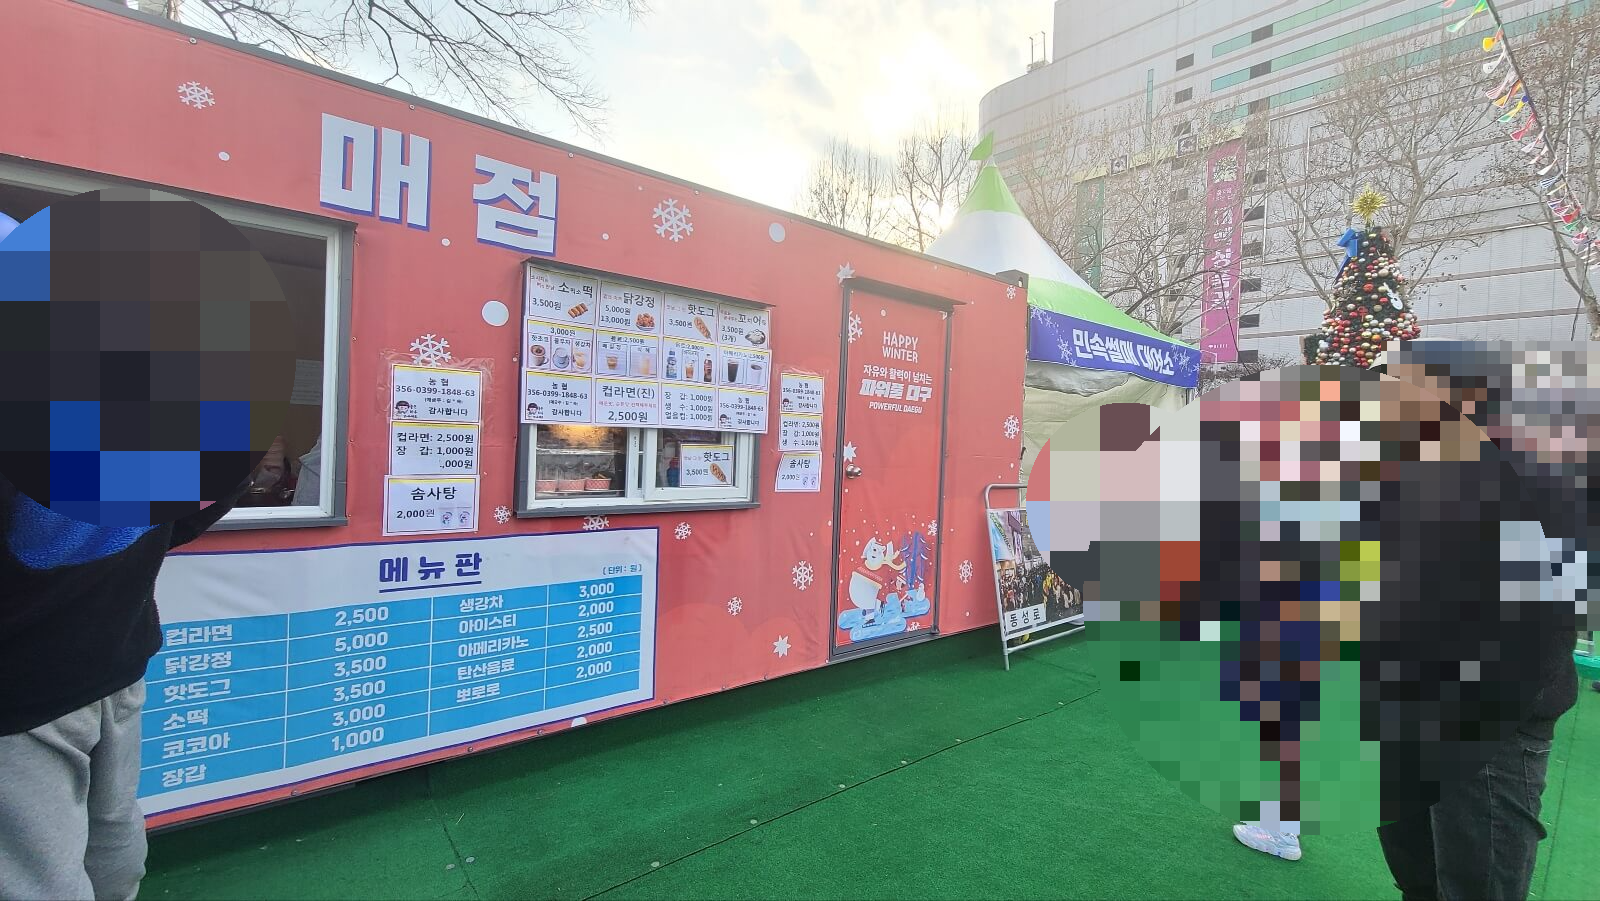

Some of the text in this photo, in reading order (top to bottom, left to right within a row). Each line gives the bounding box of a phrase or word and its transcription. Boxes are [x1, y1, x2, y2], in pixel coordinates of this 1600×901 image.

[533, 298, 561, 311] 3,500원
[624, 292, 655, 308] 닭강정
[605, 305, 630, 316] 5,000원
[688, 304, 714, 317] 핫도그
[601, 315, 630, 327] 13,000원
[669, 318, 693, 328] 3,500원
[550, 327, 576, 337] 3,000원
[722, 326, 744, 335] 3,500원
[883, 331, 918, 350] HAPPY
[882, 346, 918, 363] WINTER
[1072, 328, 1175, 376] 민속썰매 대여소
[863, 364, 933, 385] 자유와 활력이 넘치는
[395, 385, 475, 397] 356-0399-1848-63
[527, 389, 588, 400] 356-0399-1848-63
[602, 385, 655, 399] 컵라면(진)
[690, 394, 713, 403] 1,000원
[428, 407, 468, 416] 감사합니다
[551, 408, 582, 417] 감사합니다
[690, 404, 713, 413] 1,000원
[868, 401, 923, 414] POWERFUL DAEGU
[608, 411, 648, 423] 2,500원
[690, 413, 713, 422] 1,000원
[397, 432, 474, 444] 컵라면: 2,500원
[436, 446, 474, 456] 1,000원
[703, 452, 729, 462] 핫도그
[440, 460, 473, 469] ,000원
[790, 459, 810, 469] 솜사탕
[686, 469, 708, 477] 3,500원
[410, 486, 457, 501] 솜사탕
[396, 508, 435, 520] 2,000원
[459, 583, 615, 613] 생강차 3,000
[459, 601, 615, 634] 아이스티 2,000
[166, 606, 389, 647] 컵라면 2,500
[458, 622, 614, 659] 아메리카노 2,500
[165, 631, 389, 675] 닭강정 5,000
[457, 642, 614, 681] 탄산음료 2,000
[164, 655, 388, 704] 핫도그 3,500
[456, 661, 613, 704] 뽀로로 2,000
[163, 680, 387, 732] 소떡 3,500
[162, 703, 386, 759] 코코아 3,000
[162, 727, 385, 789] 장갑 1,000
